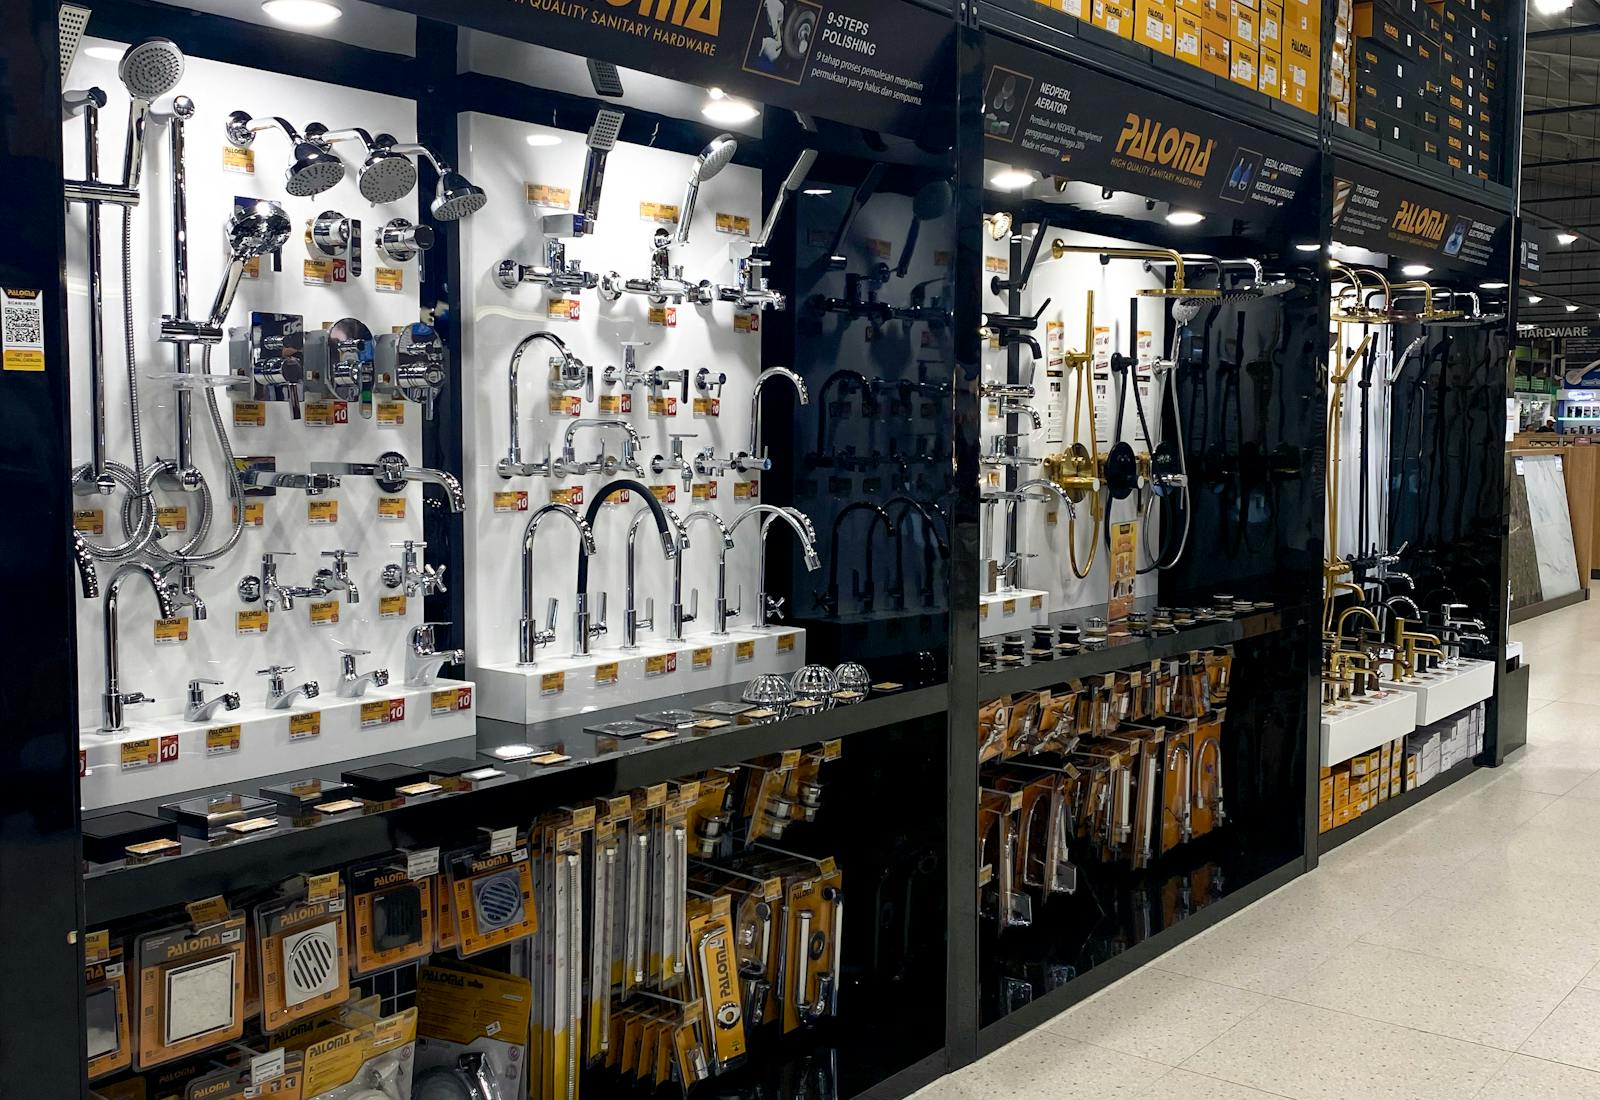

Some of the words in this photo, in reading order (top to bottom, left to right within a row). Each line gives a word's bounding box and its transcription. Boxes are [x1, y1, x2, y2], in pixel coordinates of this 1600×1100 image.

[529, 0, 588, 21] QUALITY
[590, 10, 651, 41] SANITARY
[653, 28, 717, 57] HARDWARE
[827, 11, 869, 36] 9-STEPS
[821, 29, 876, 56] POLISHING
[1291, 38, 1312, 58] PALOMA
[816, 51, 821, 61] 9
[821, 54, 840, 68] tahap
[840, 60, 861, 72] proses
[861, 66, 894, 83] pemolesan
[894, 75, 924, 91] menjamin
[810, 68, 847, 84] permukaan
[847, 79, 864, 91] yang
[864, 82, 881, 94] halus
[880, 86, 893, 97] dan
[1040, 82, 1072, 102] NEOPERL
[1034, 97, 1068, 115] AERATOR
[1115, 112, 1214, 177] PALOMA
[1110, 157, 1126, 169] HIGH
[1126, 161, 1150, 175] QUALITY
[1150, 167, 1176, 182] SANITARY
[1175, 175, 1203, 189] HARDWARE
[1391, 200, 1448, 241] PALOMA
[334, 267, 346, 279] 10
[8, 289, 36, 298] PALOMA
[1519, 326, 1588, 339] HARDWARE
[621, 400, 631, 411] 10
[667, 403, 677, 414] 10
[334, 409, 347, 422] 10
[516, 499, 527, 510] 10
[573, 492, 583, 503] 10
[458, 694, 471, 708] 10
[390, 706, 404, 719] 10
[161, 744, 178, 759] 10
[471, 854, 509, 873] PALOMA
[280, 902, 325, 927] PALOMA
[167, 934, 221, 958] PALOMA
[422, 969, 465, 987] PALOMA
[273, 1019, 314, 1044] PALOMA
[309, 1034, 351, 1058] PALOMA
[193, 1080, 231, 1099] PALOMA
